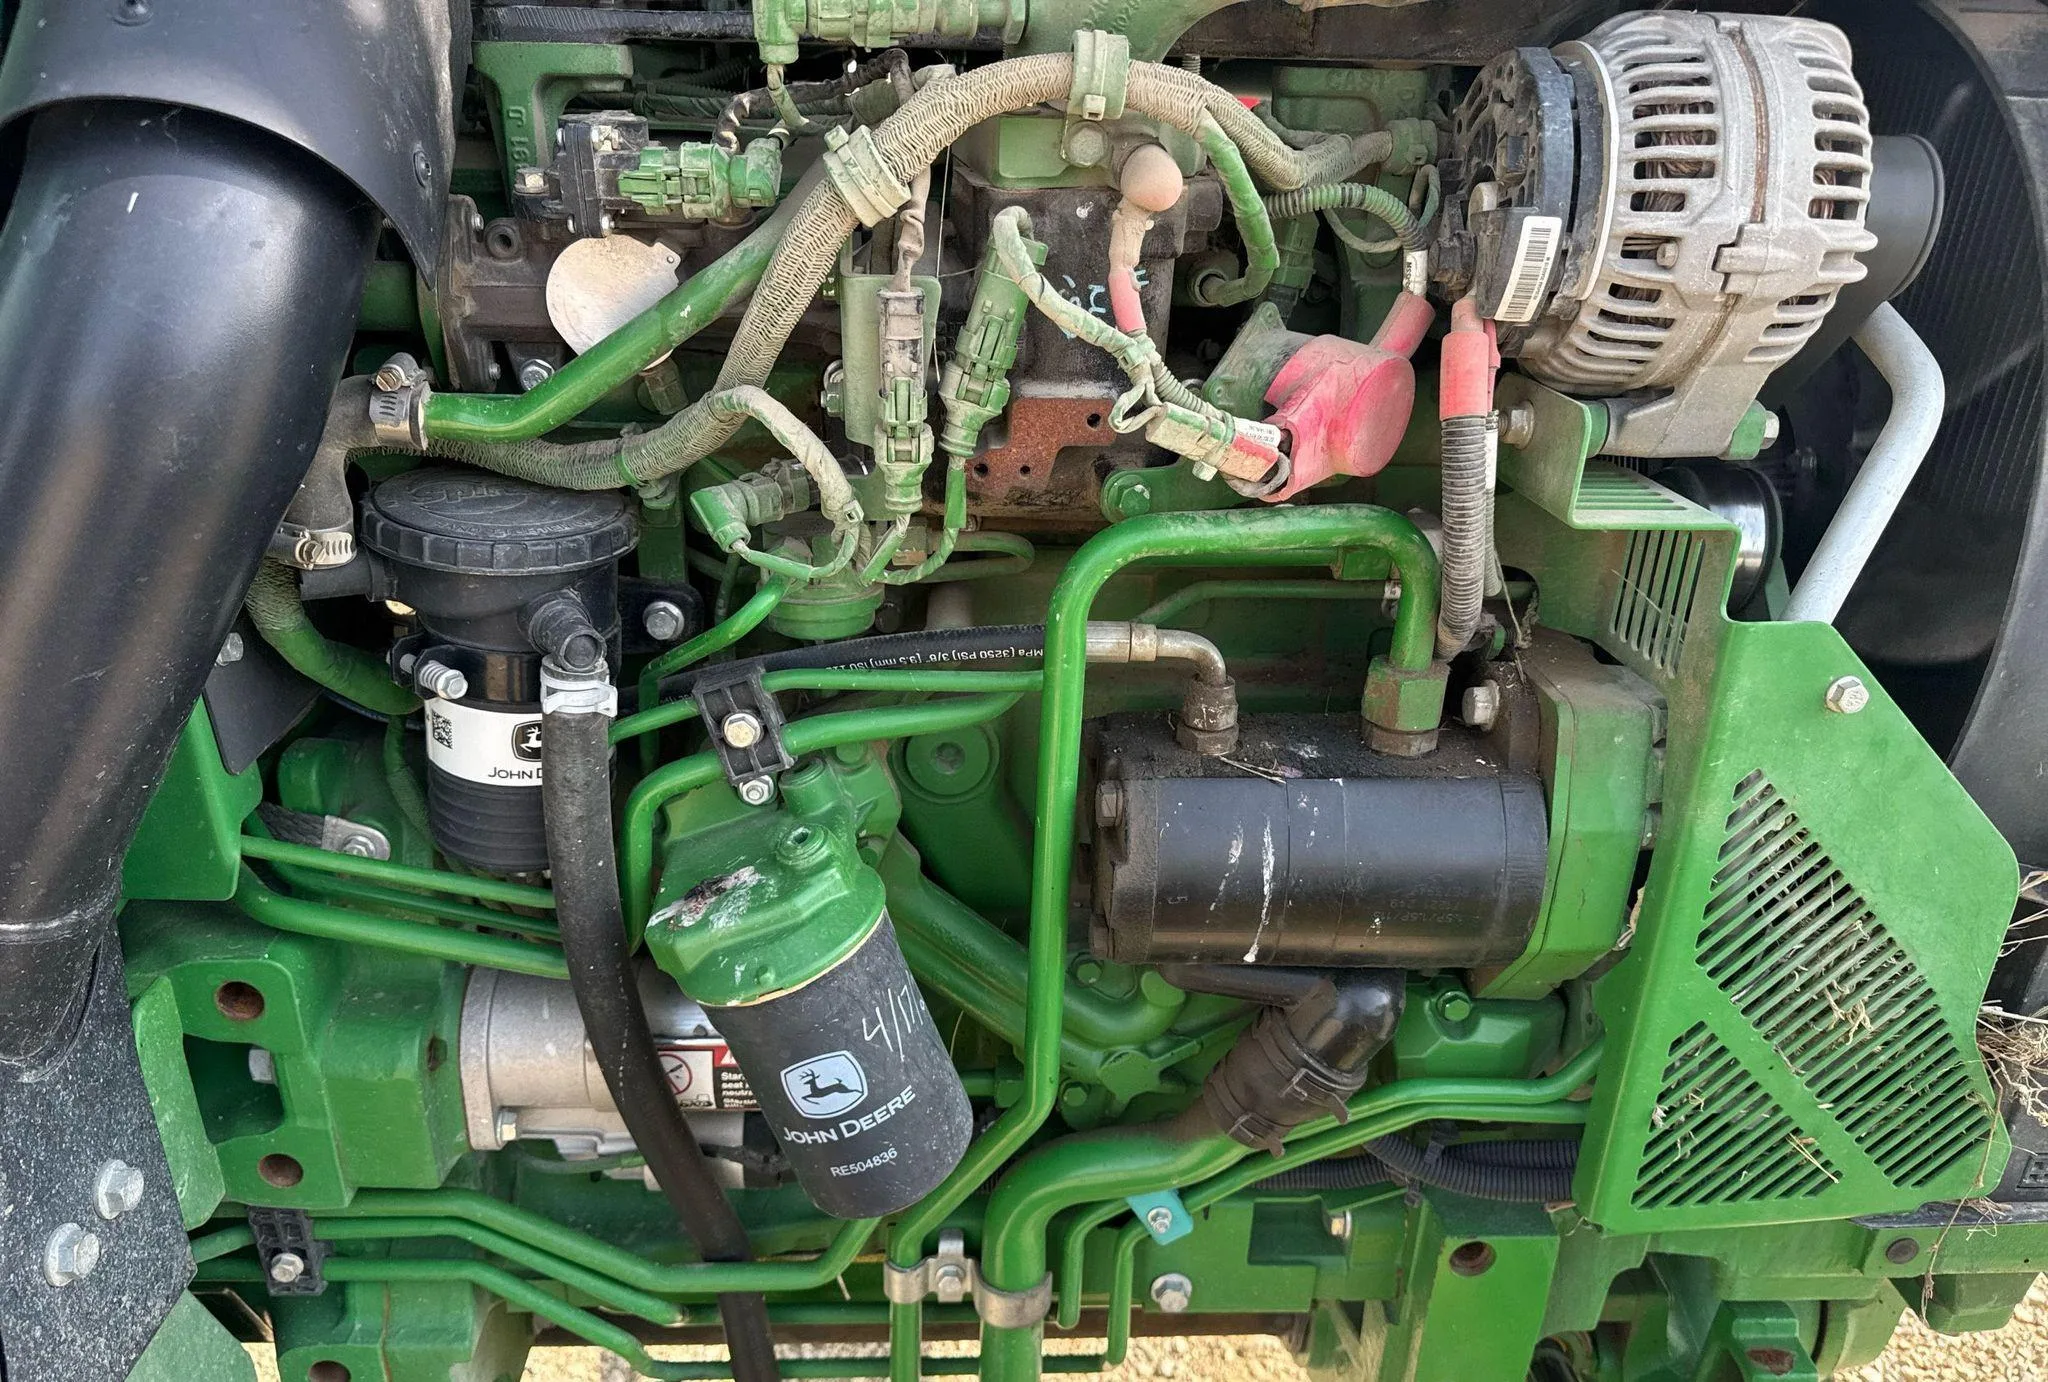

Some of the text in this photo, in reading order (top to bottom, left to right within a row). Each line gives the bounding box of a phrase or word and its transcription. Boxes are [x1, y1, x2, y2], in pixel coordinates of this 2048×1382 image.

[1018, 648, 1044, 657] MPa
[487, 766, 533, 780] JOHN
[720, 1071, 746, 1081] Star
[783, 1084, 916, 1145] JOHN DEERE
[829, 1146, 898, 1178] RE504836
